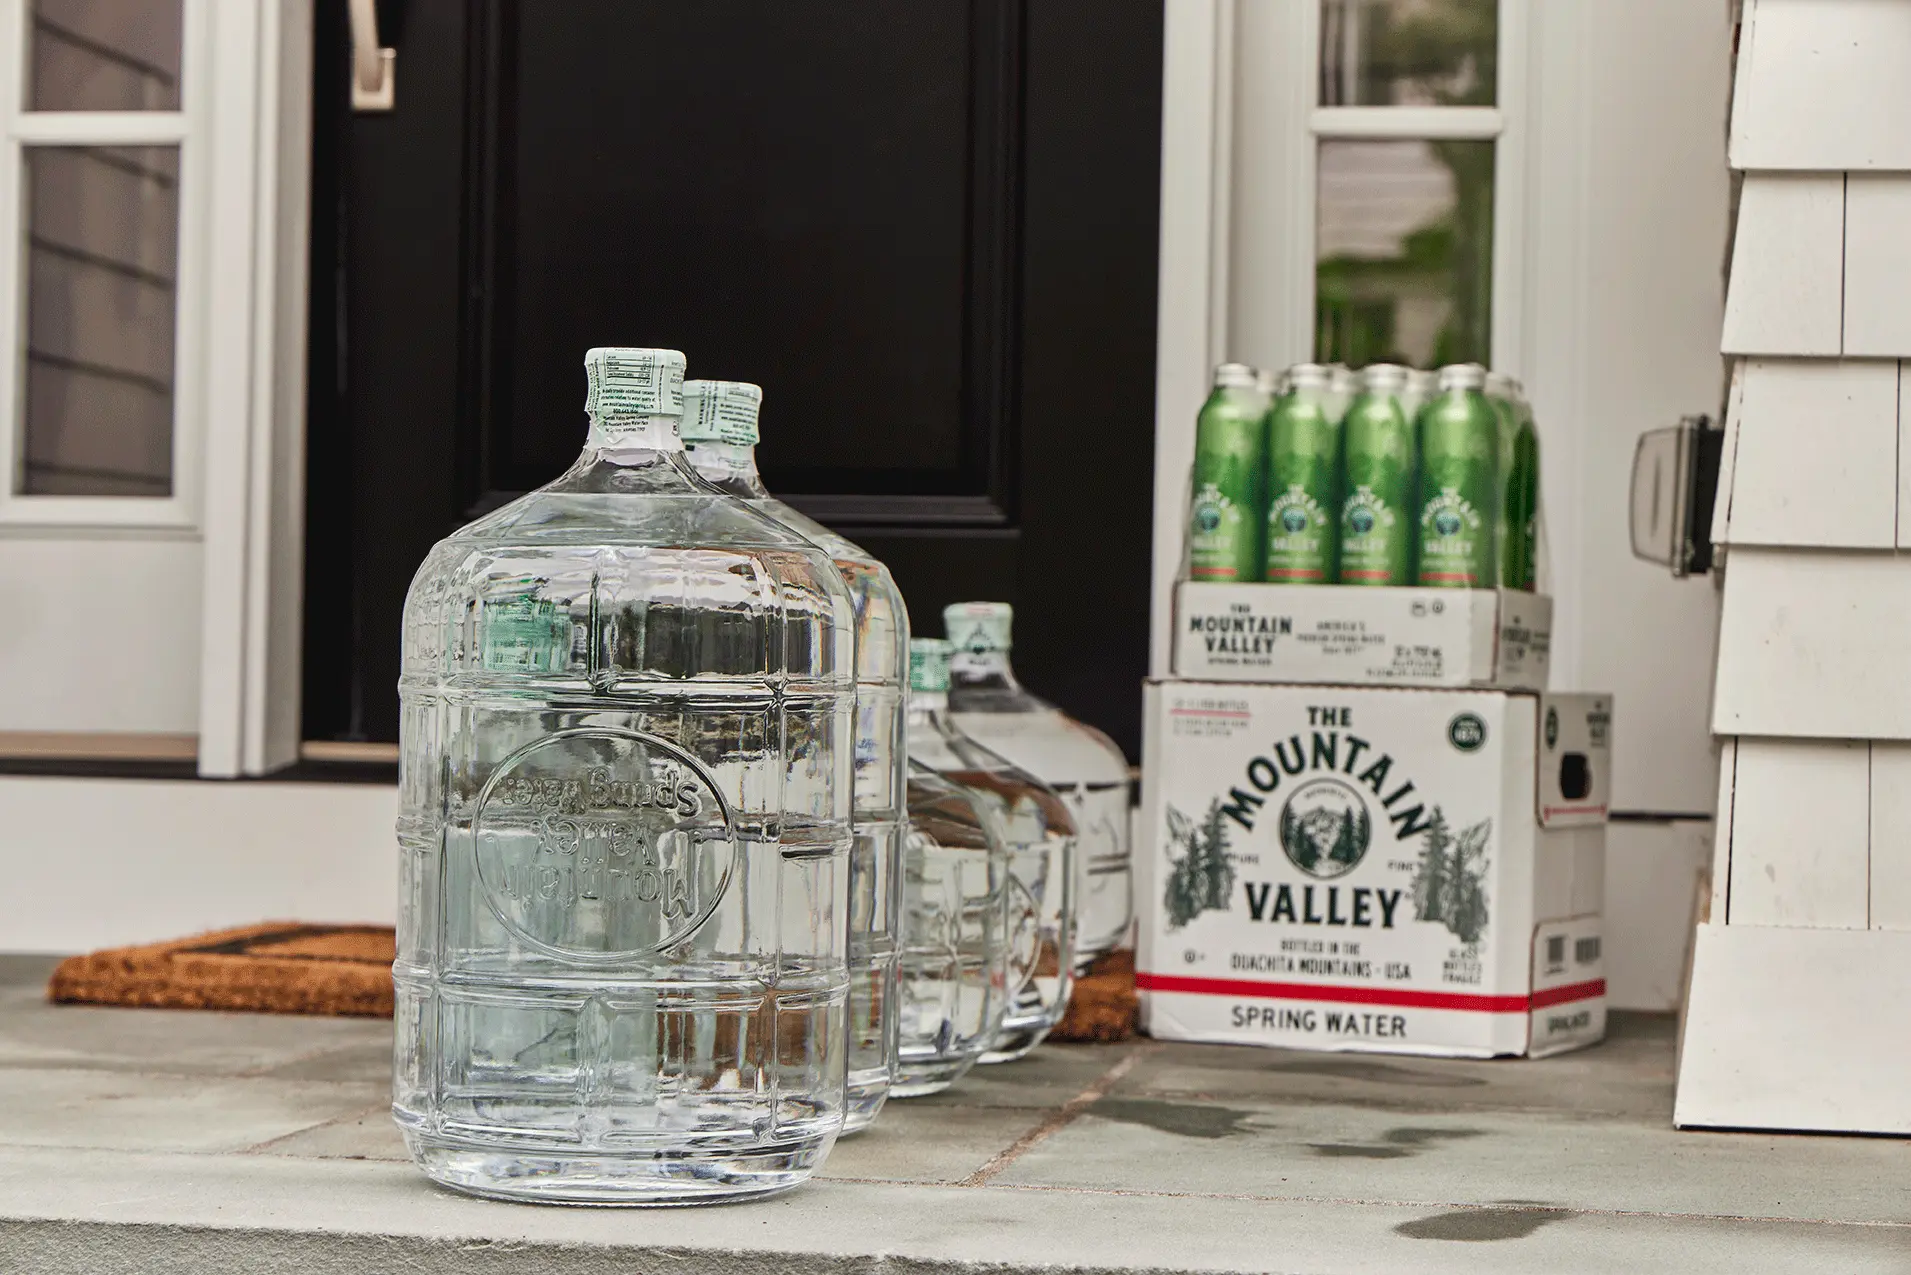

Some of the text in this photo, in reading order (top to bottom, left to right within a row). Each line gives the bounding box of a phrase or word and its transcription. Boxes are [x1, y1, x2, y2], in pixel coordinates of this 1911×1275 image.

[1190, 616, 1292, 635] MOUNTAIN
[1205, 635, 1275, 654] VALLEY
[1306, 705, 1352, 727] THE
[1220, 731, 1432, 843] MOUNTAIN
[1244, 881, 1401, 929] VALLEY
[1231, 953, 1294, 973] OUACHITA
[1298, 957, 1373, 978] MOUNTAINS
[1384, 962, 1412, 980] USA
[1231, 1005, 1408, 1038] SPRING WATER
